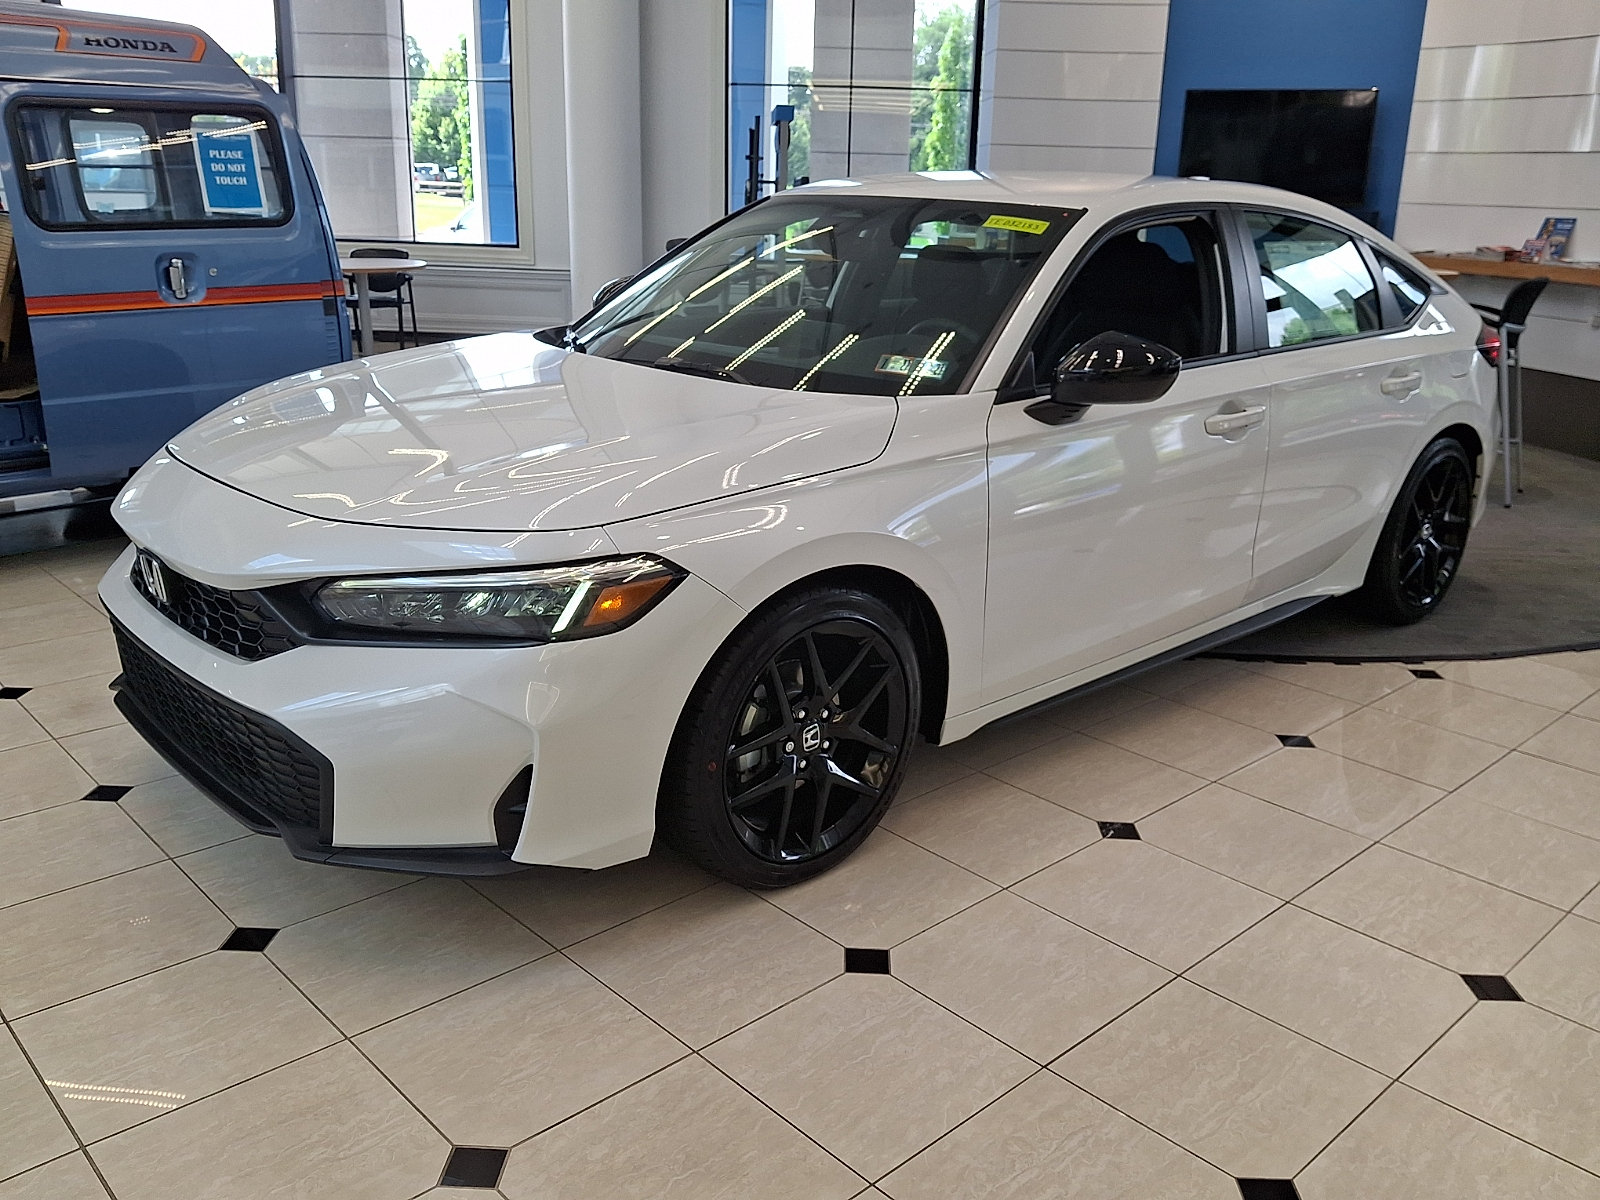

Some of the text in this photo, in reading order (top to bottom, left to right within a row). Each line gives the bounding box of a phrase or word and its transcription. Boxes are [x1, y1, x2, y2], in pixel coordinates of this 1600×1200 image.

[84, 37, 177, 53] HONDA
[209, 149, 244, 160] PLEASE
[210, 162, 246, 173] DO NOT
[215, 175, 247, 186] TOUCH
